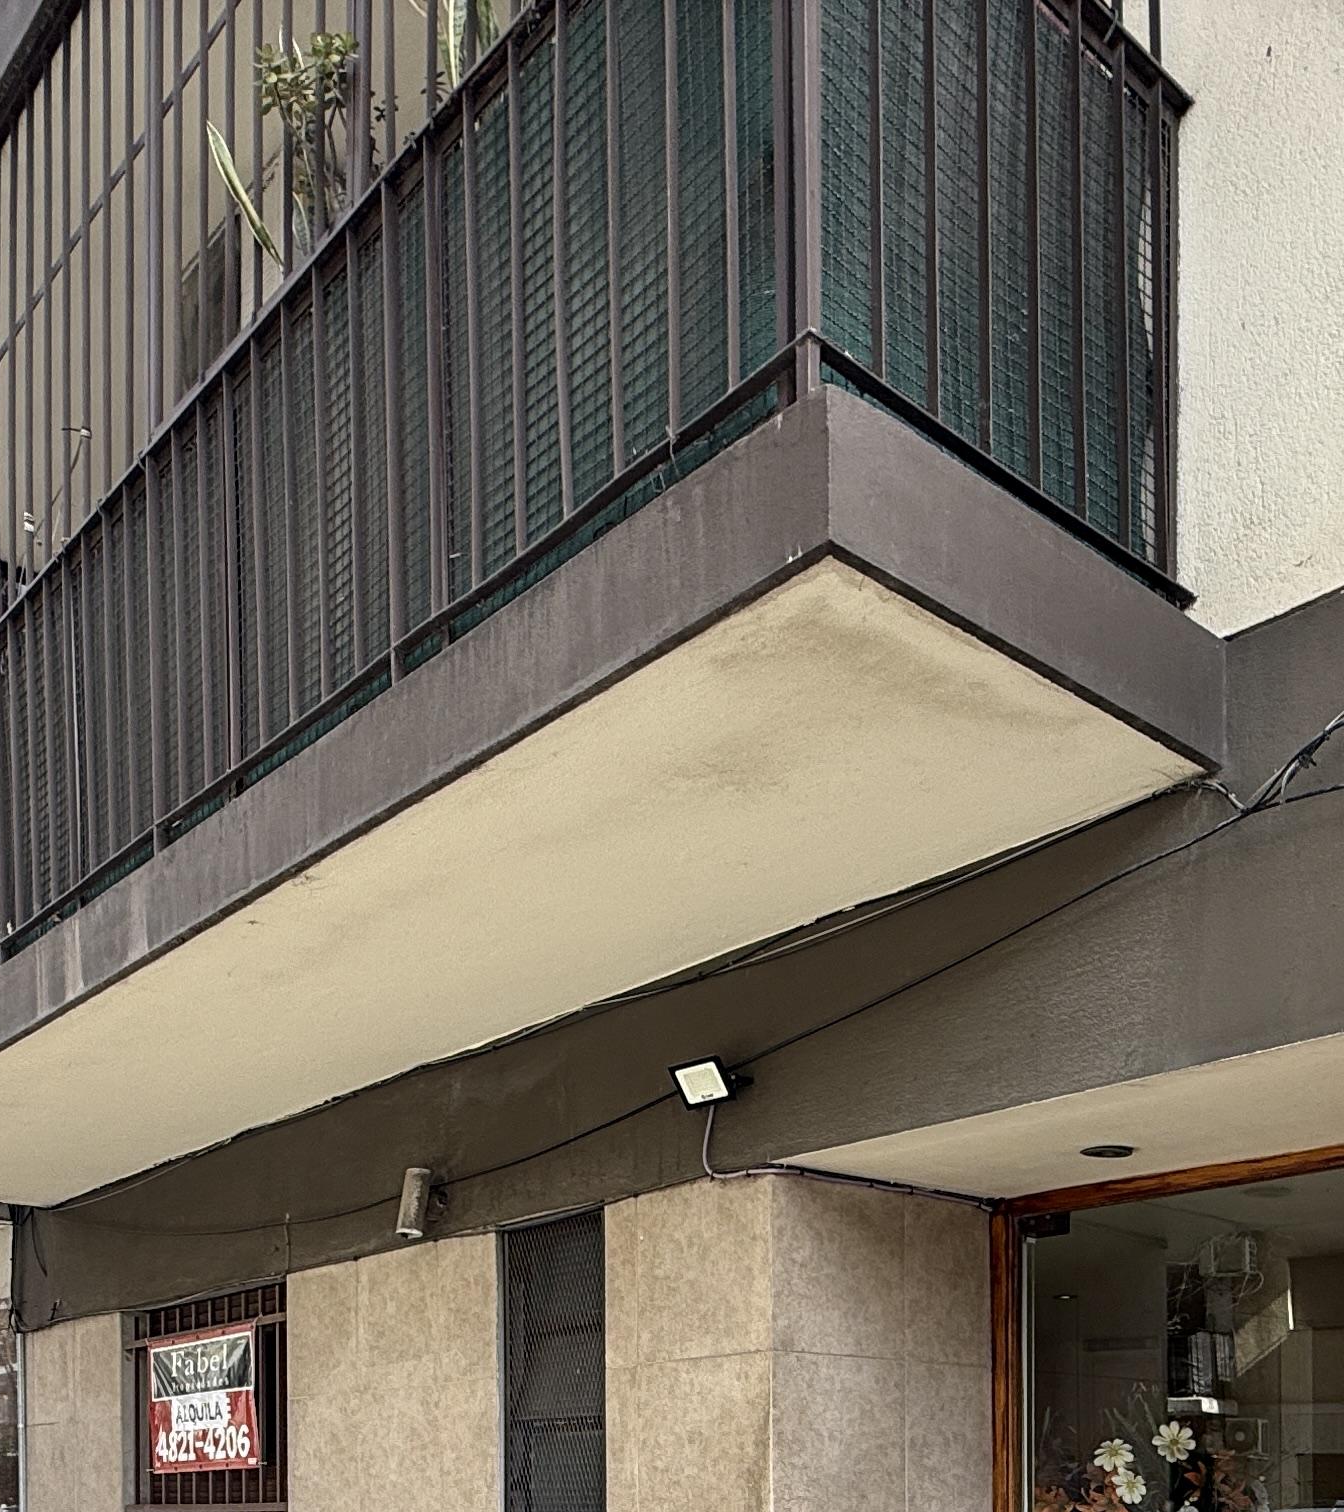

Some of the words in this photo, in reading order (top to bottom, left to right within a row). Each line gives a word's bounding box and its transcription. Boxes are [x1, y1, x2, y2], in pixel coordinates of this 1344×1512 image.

[170, 1343, 227, 1377] Fabel
[176, 1401, 223, 1424] ALQUILA
[155, 1424, 251, 1462] 4821-4206
